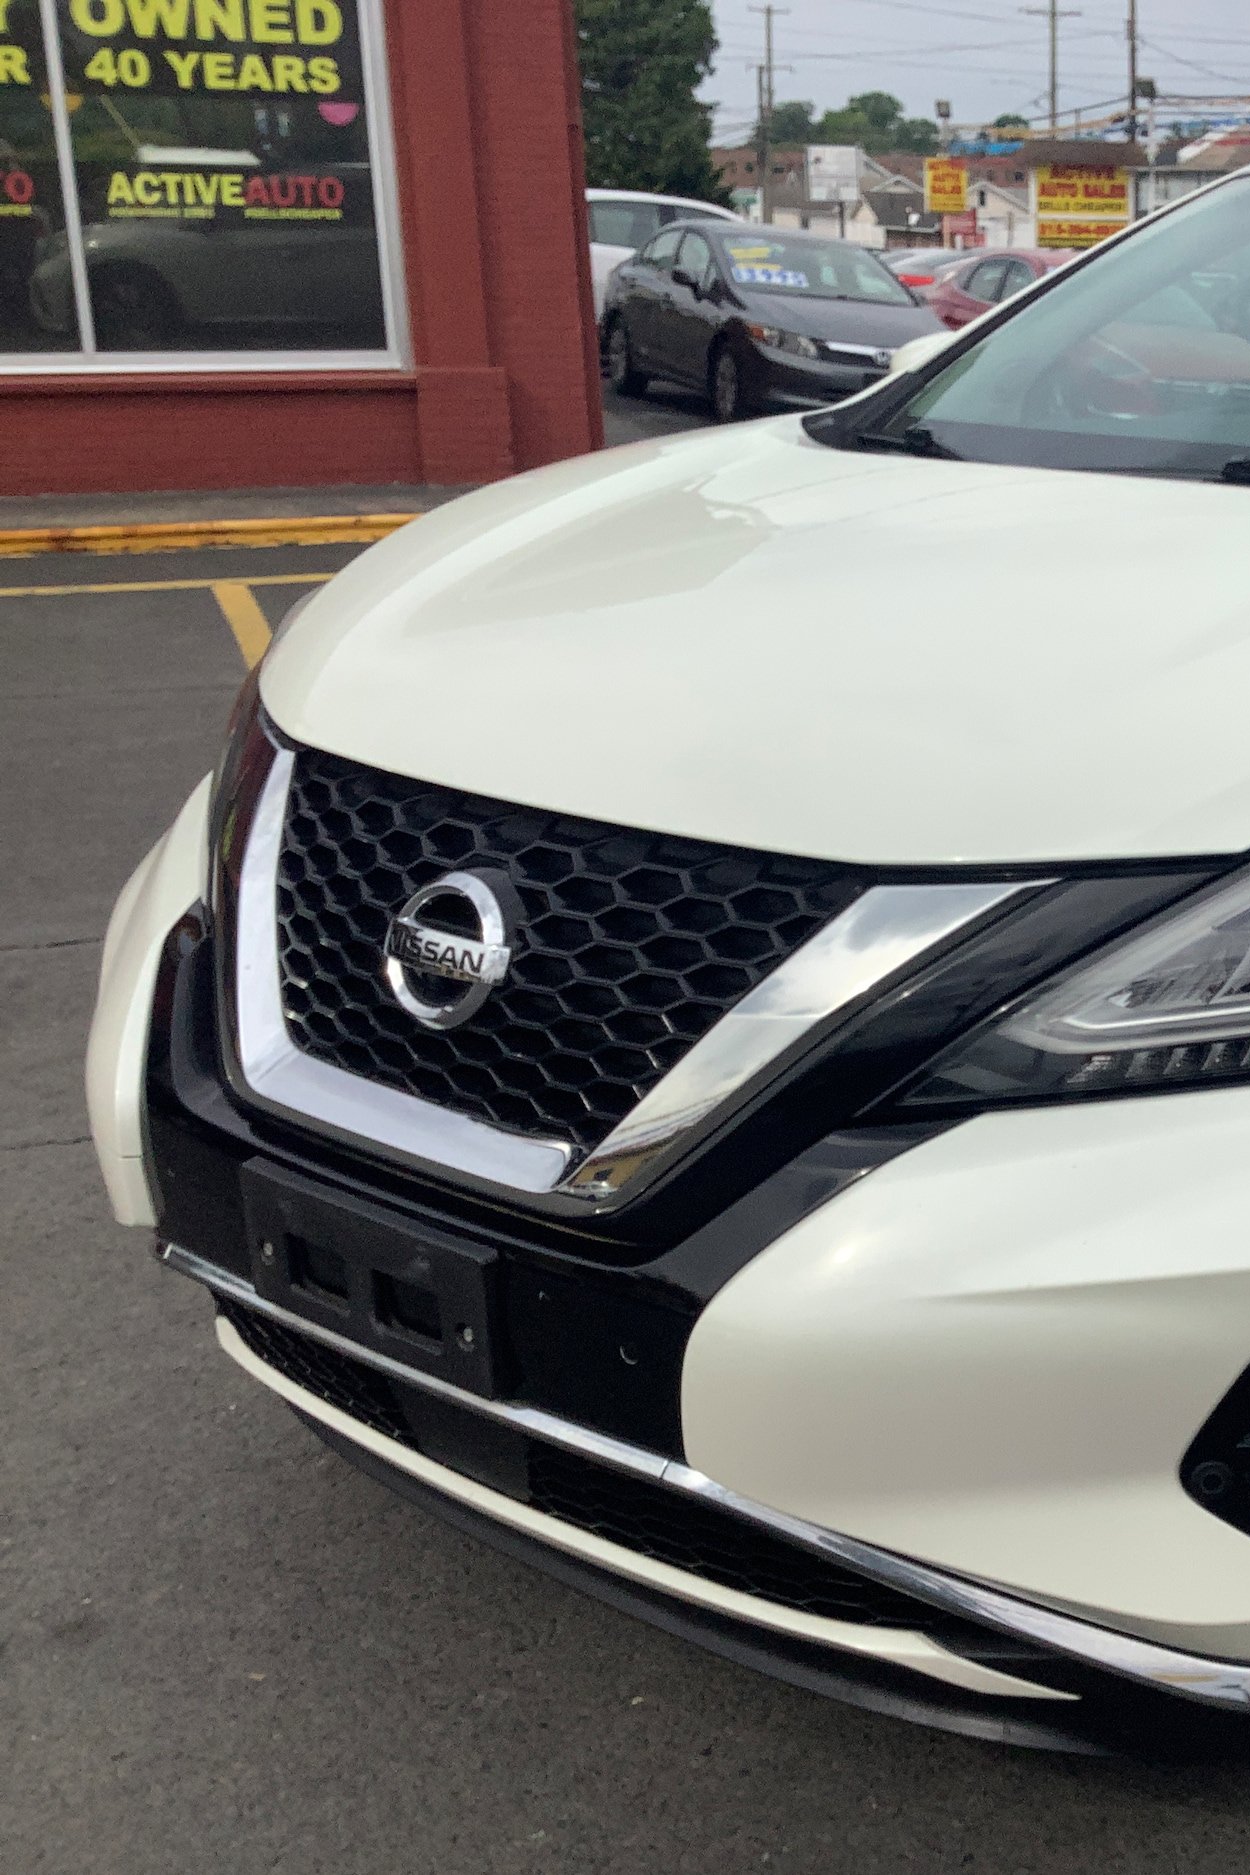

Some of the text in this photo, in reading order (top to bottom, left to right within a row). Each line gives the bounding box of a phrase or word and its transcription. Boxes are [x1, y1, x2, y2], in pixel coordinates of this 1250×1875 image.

[69, 0, 343, 46] OWNED
[84, 47, 341, 94] 40 YEARS
[390, 922, 485, 975] NISSAN
